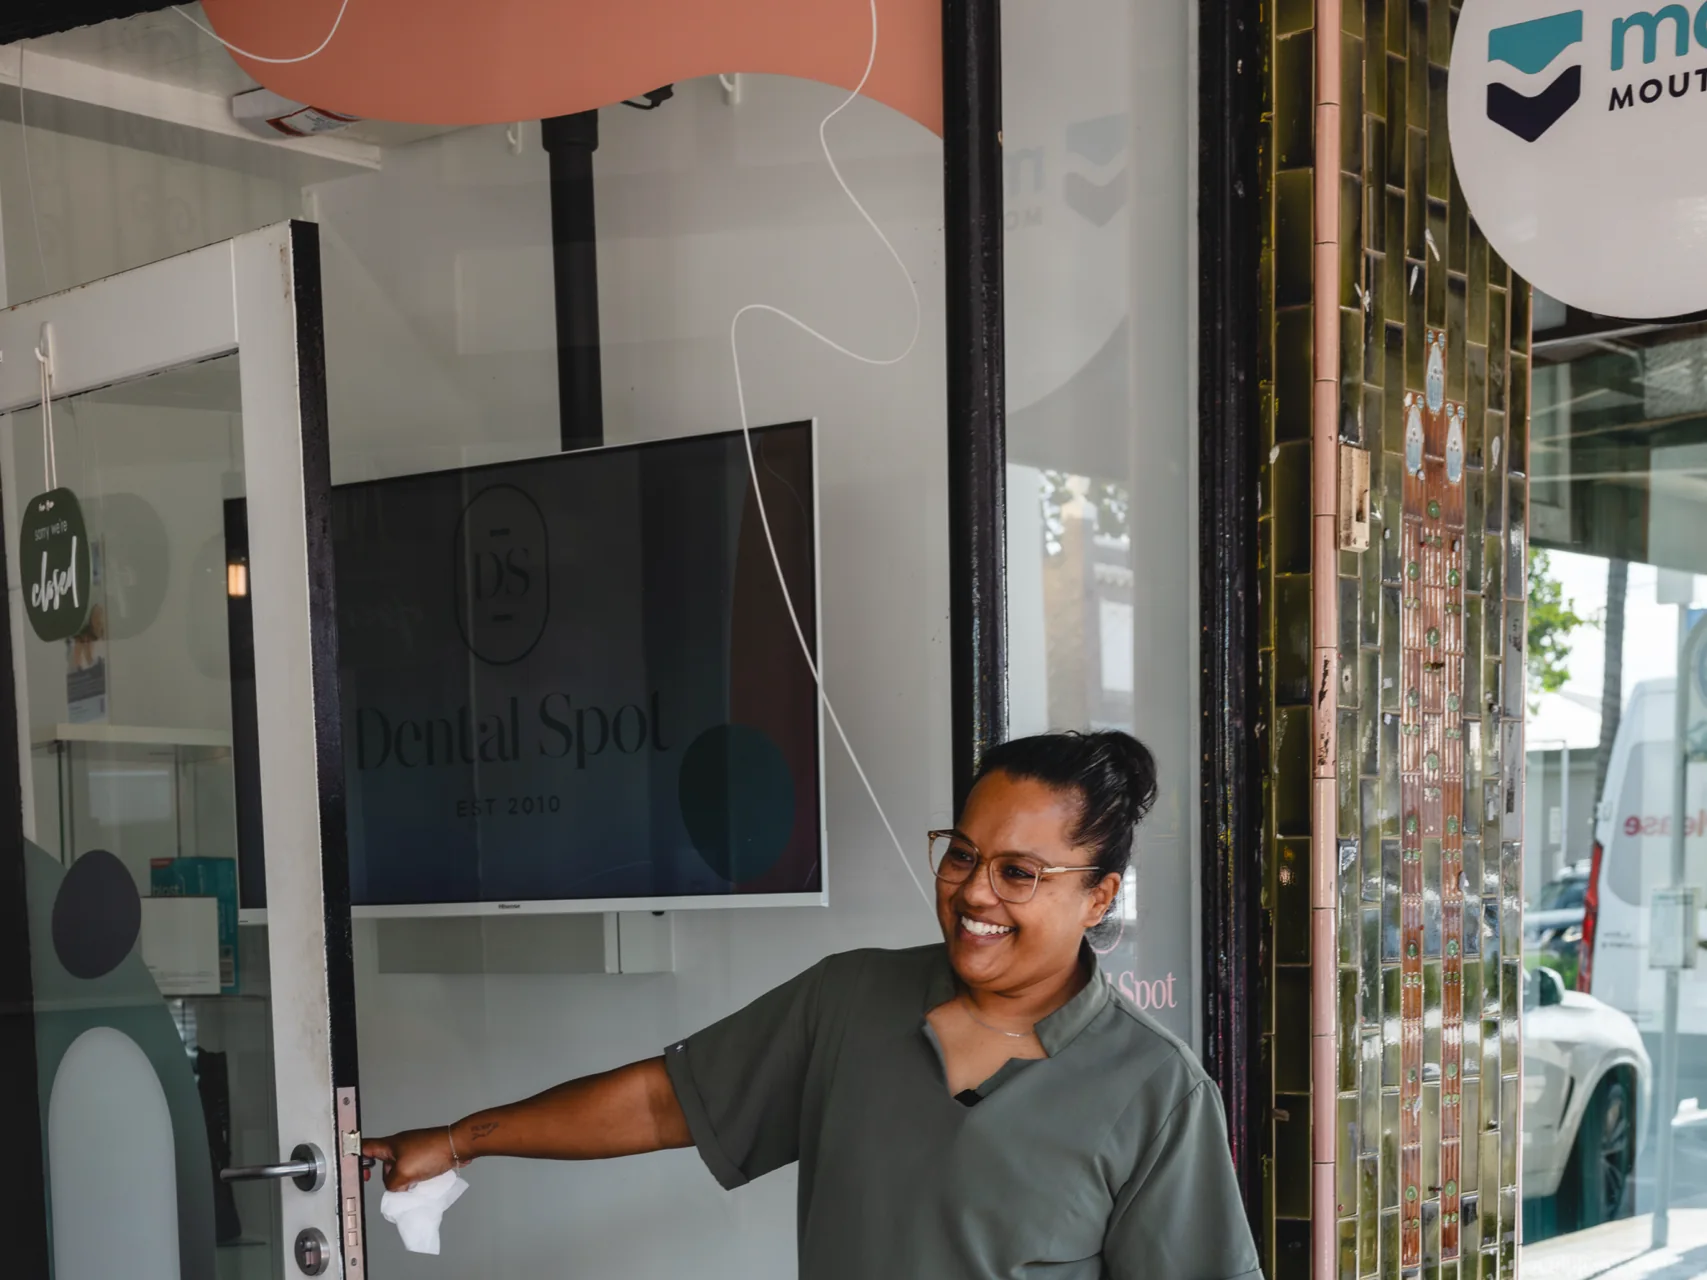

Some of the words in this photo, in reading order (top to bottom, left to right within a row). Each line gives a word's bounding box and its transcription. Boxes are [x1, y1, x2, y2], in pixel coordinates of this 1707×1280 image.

[34, 526, 50, 541] sorry
[50, 518, 68, 535] we're
[32, 535, 79, 612] closed
[474, 547, 530, 601] DS
[355, 696, 520, 770] Dental
[538, 689, 674, 770] Spot
[456, 798, 497, 818] EST
[507, 795, 561, 815] 2010
[1117, 970, 1178, 1010] Spot
